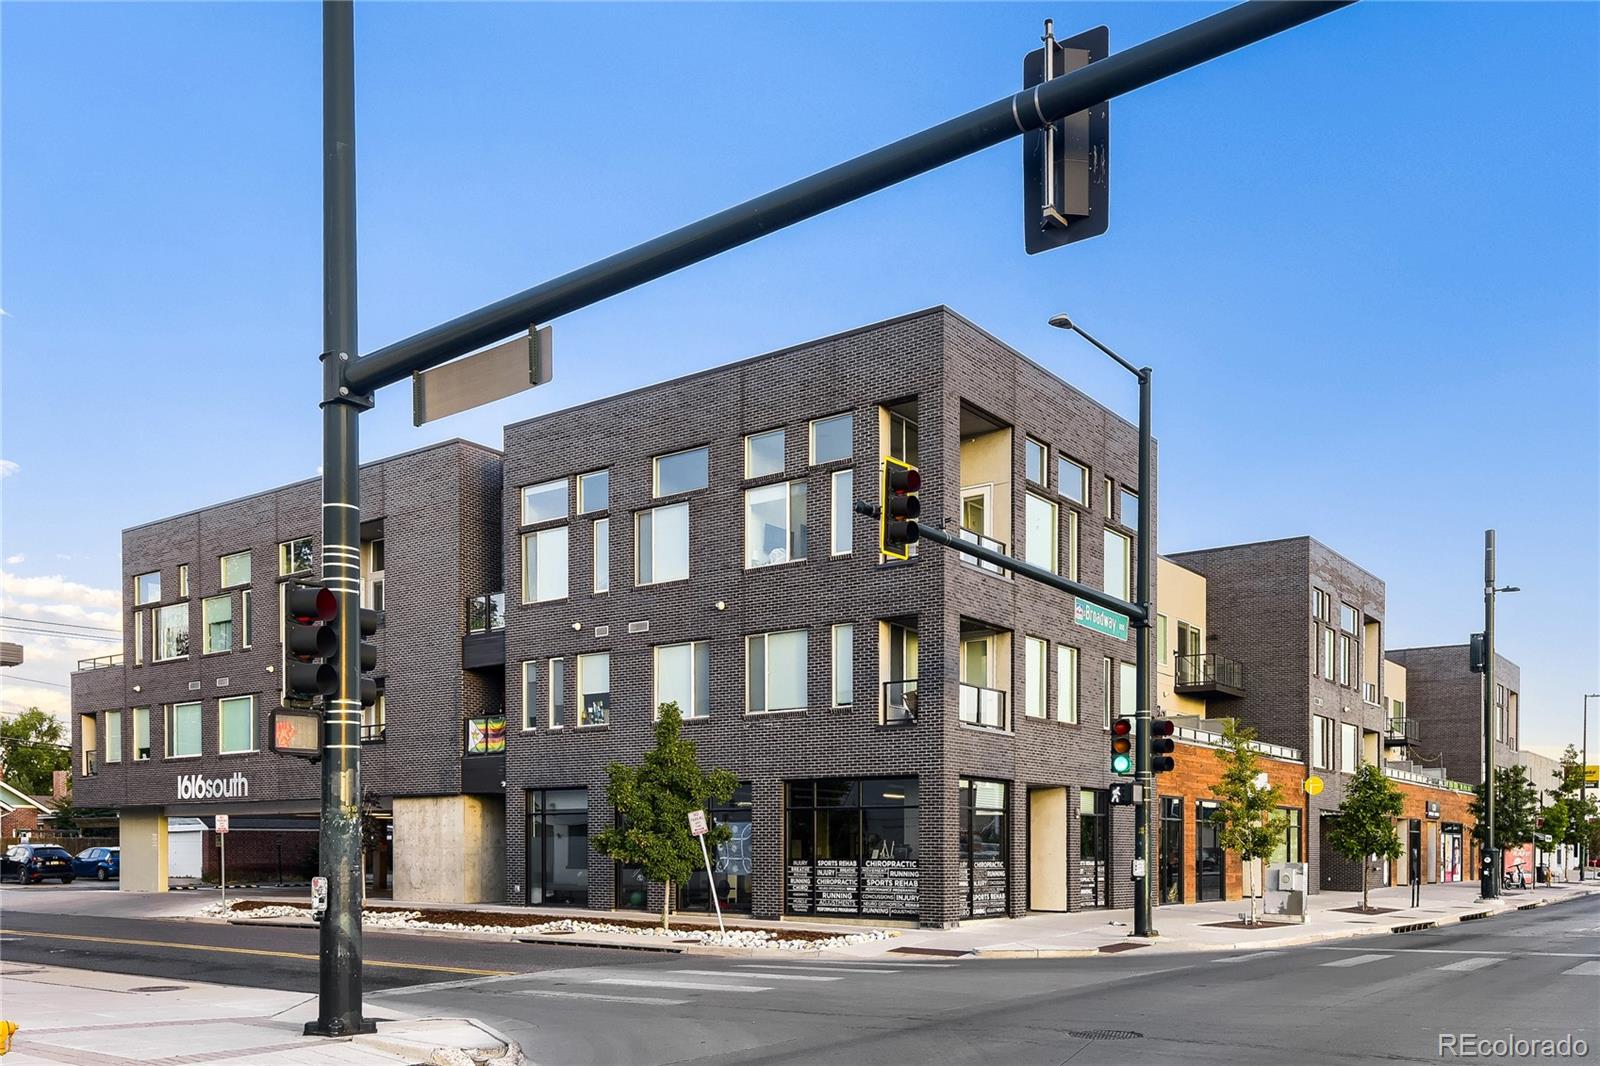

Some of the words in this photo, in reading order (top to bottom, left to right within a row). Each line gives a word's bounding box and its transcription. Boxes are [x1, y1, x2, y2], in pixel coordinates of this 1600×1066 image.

[1085, 604, 1117, 635] Broadway
[177, 772, 249, 800] 1616south
[865, 860, 917, 868] CHIROPRACTIC
[889, 870, 920, 878] RUNNING
[816, 878, 859, 886] CHIROPRACTIC
[866, 879, 893, 887] SPORTS
[894, 879, 919, 887] REHAB
